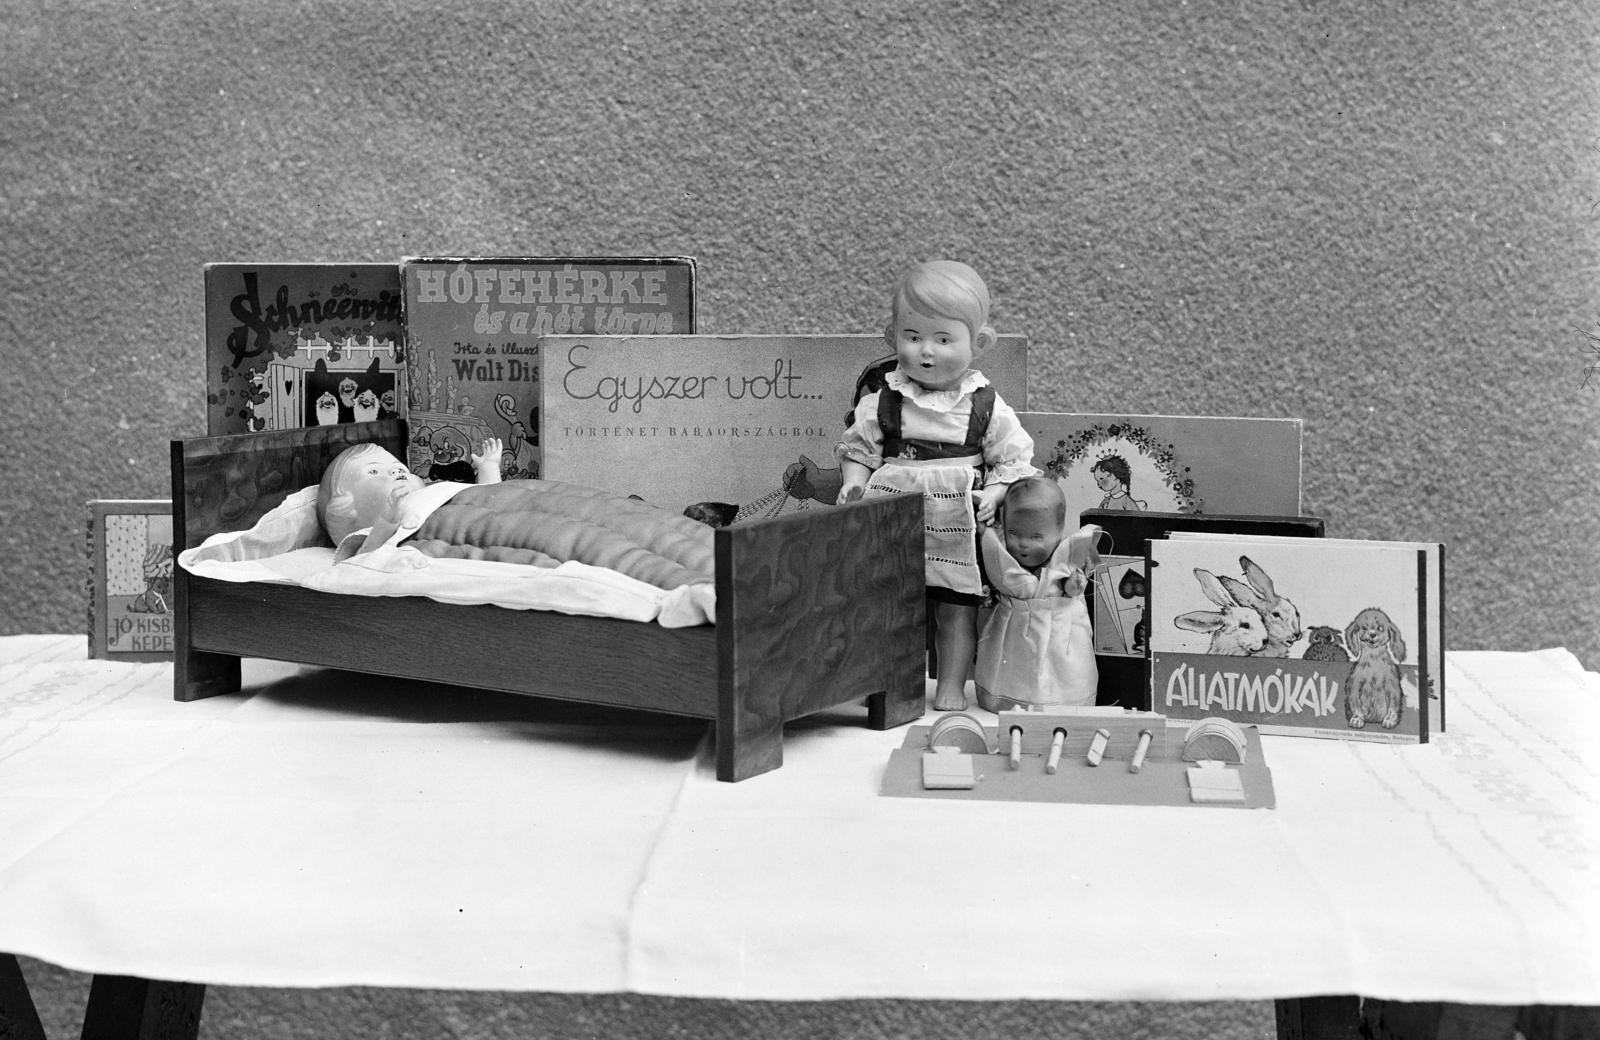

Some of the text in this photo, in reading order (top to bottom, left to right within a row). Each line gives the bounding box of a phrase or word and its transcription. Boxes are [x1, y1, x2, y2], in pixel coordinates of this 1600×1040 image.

[416, 262, 667, 306] HÓFEHÉRKE
[474, 304, 506, 334] és
[510, 312, 530, 334] a
[531, 304, 585, 334] hét
[484, 343, 497, 354] és
[452, 359, 504, 381] Walt
[563, 344, 823, 413] Egyszer volt...
[563, 424, 659, 437] TÖRTÉNET
[109, 615, 174, 646] JÓ KISB
[1165, 662, 1339, 717] ÁLLATMÓKÁK
